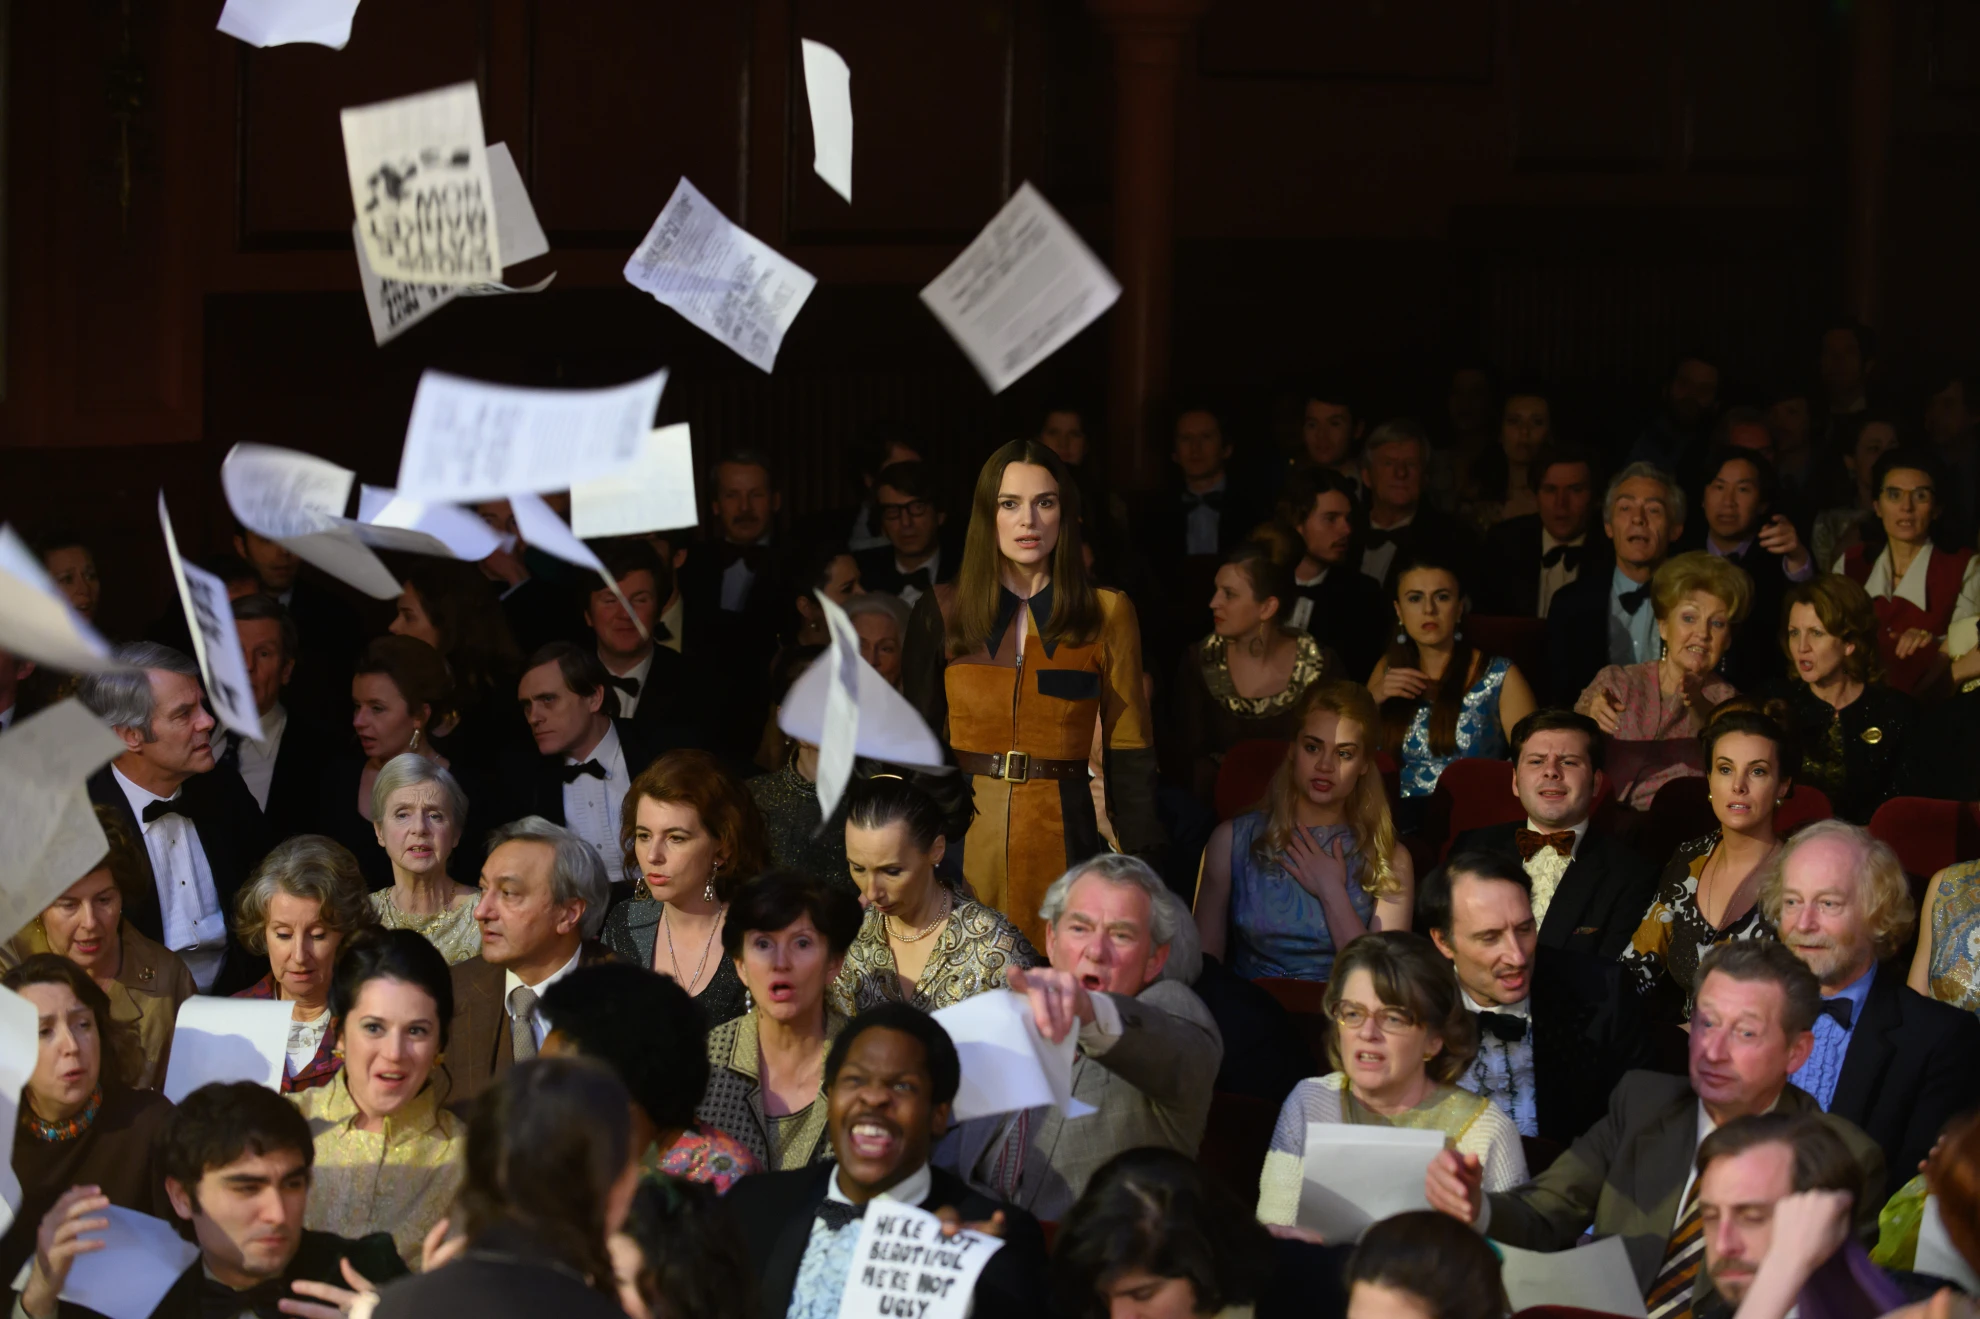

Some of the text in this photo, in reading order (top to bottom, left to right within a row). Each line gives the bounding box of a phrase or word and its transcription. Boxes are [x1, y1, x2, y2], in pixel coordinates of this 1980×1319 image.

[869, 1241, 963, 1270] BEAUTIFUL
[917, 1273, 955, 1299] NOT
[879, 1295, 930, 1319] UGLY
